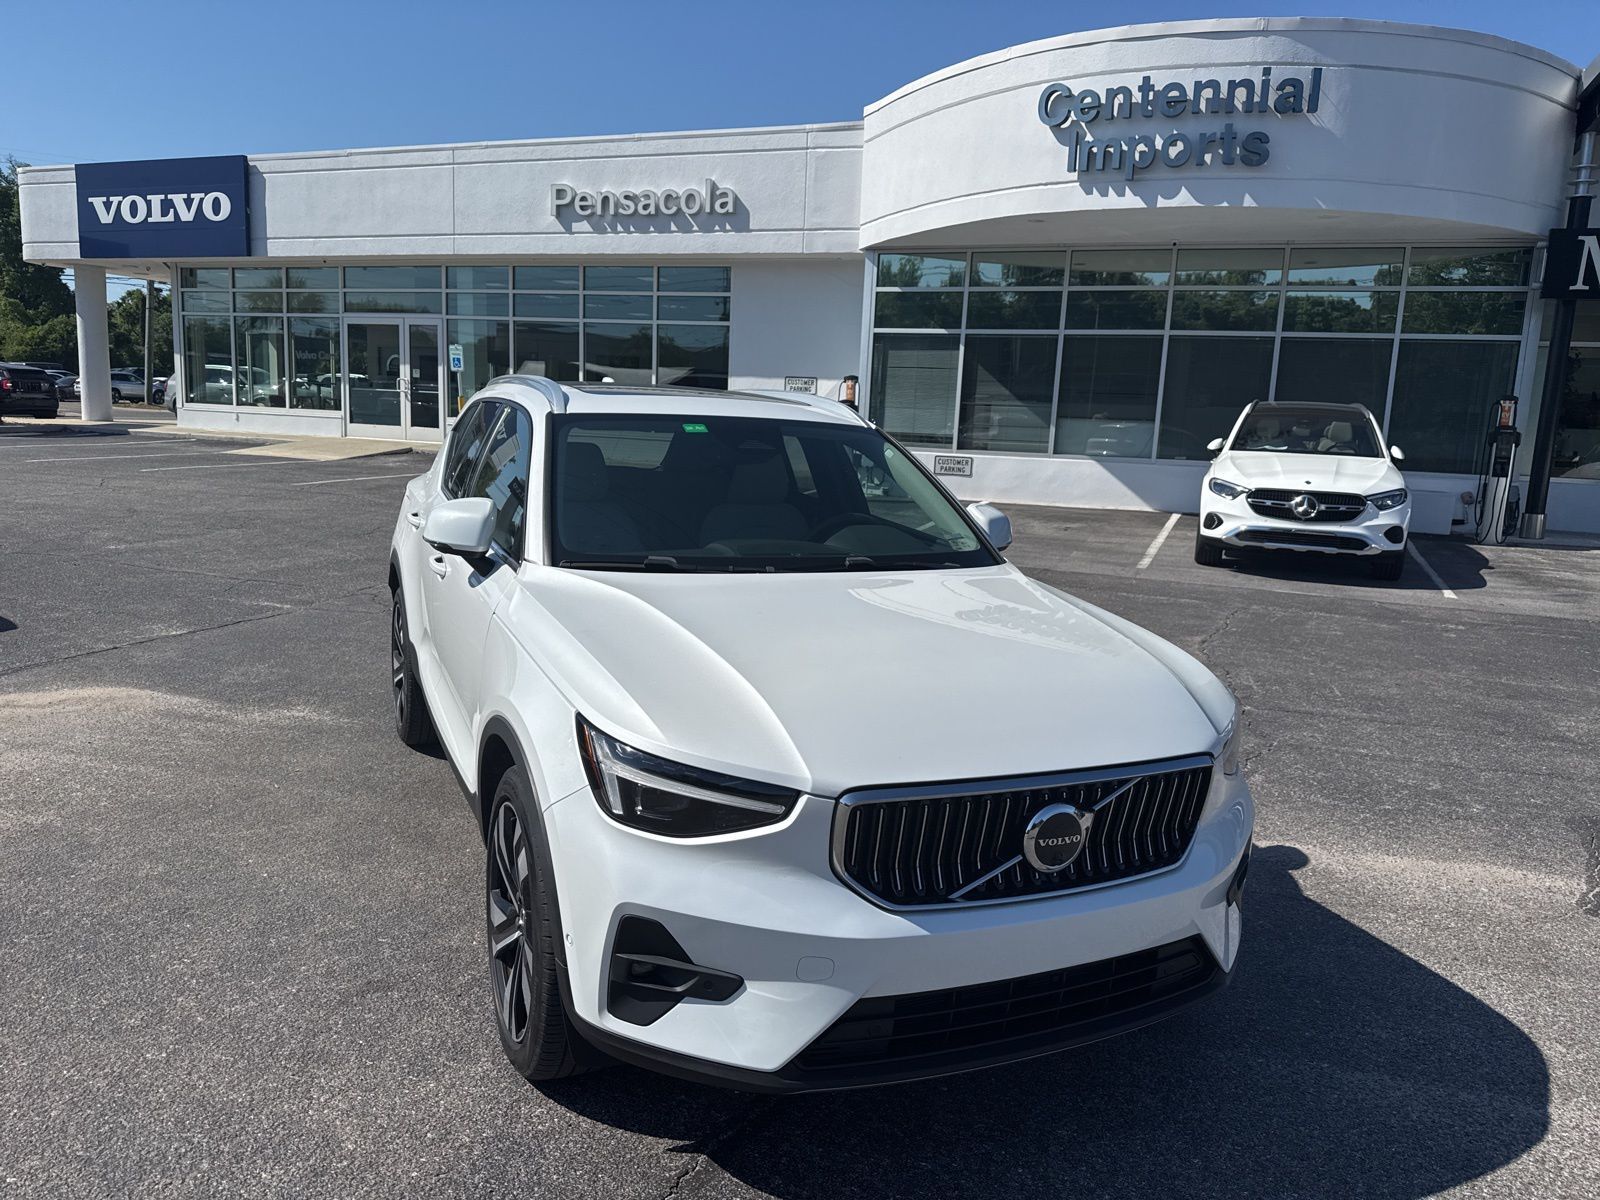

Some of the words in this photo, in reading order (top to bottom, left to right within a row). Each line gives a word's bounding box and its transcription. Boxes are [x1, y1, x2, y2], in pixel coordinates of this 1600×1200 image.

[1038, 67, 1322, 128] Centennial
[1067, 122, 1270, 181] Imports
[88, 191, 232, 225] VOLVO
[550, 178, 736, 217] Pensacola
[937, 458, 970, 466] CUSTOMER
[940, 466, 966, 474] PARKING
[1038, 834, 1081, 847] VOLVO
